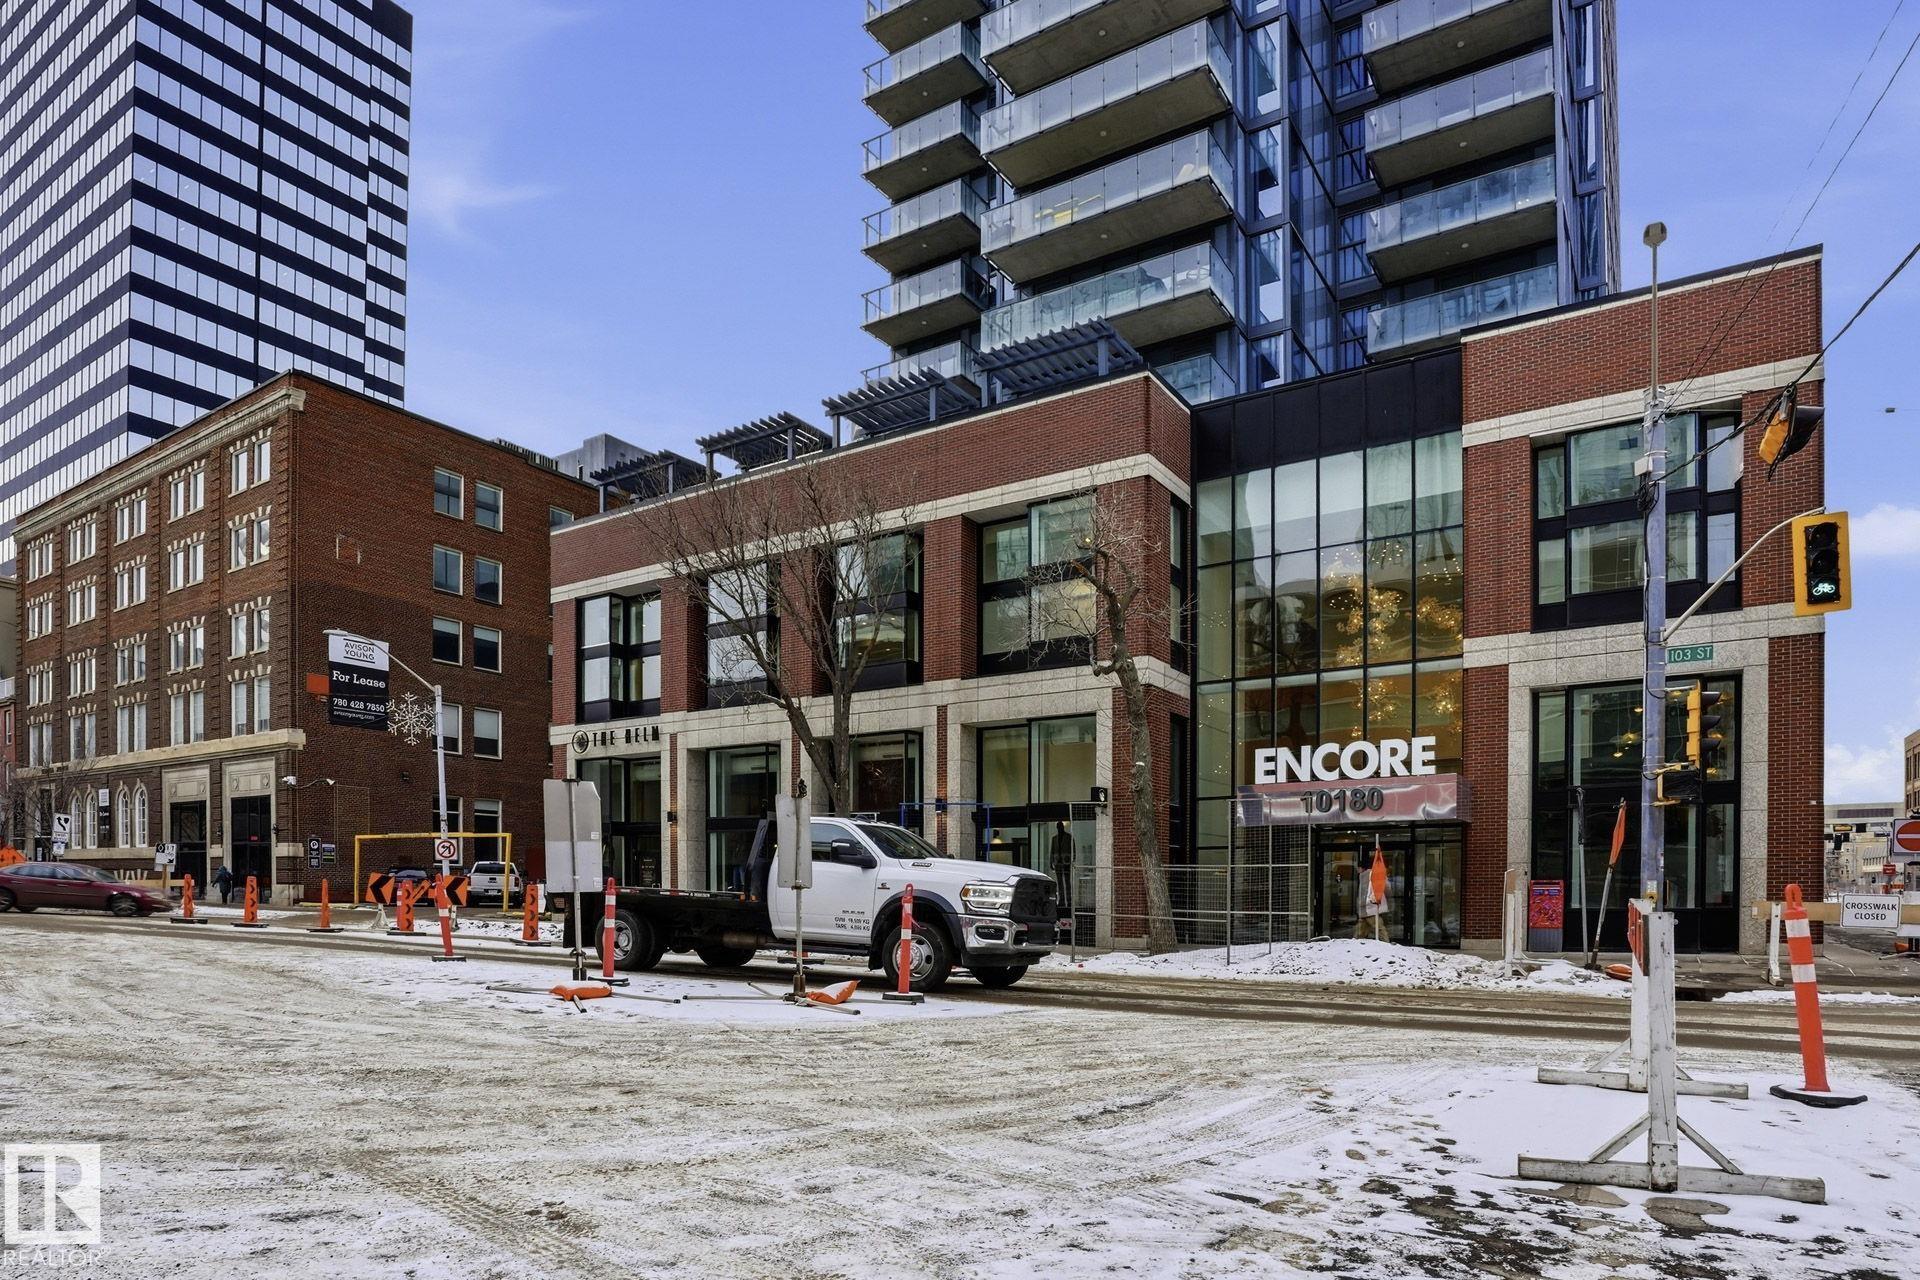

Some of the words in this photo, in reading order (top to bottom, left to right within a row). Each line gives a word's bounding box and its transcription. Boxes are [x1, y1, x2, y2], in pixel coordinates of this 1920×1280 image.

[344, 642, 375, 653] AVISON
[344, 649, 375, 660] YOUNG
[1671, 649, 1691, 661] 103
[1696, 646, 1712, 659] ST
[332, 670, 350, 682] For
[353, 673, 386, 688] Lease
[332, 698, 348, 707] 780
[350, 700, 365, 709] 428
[366, 702, 385, 712] 7850
[593, 730, 615, 747] THE
[625, 725, 660, 744] HELM
[1255, 736, 1436, 784] ENCORE
[1301, 787, 1384, 814] 10180
[1845, 902, 1898, 911] CROSSWALK
[1854, 912, 1887, 921] CLOSED
